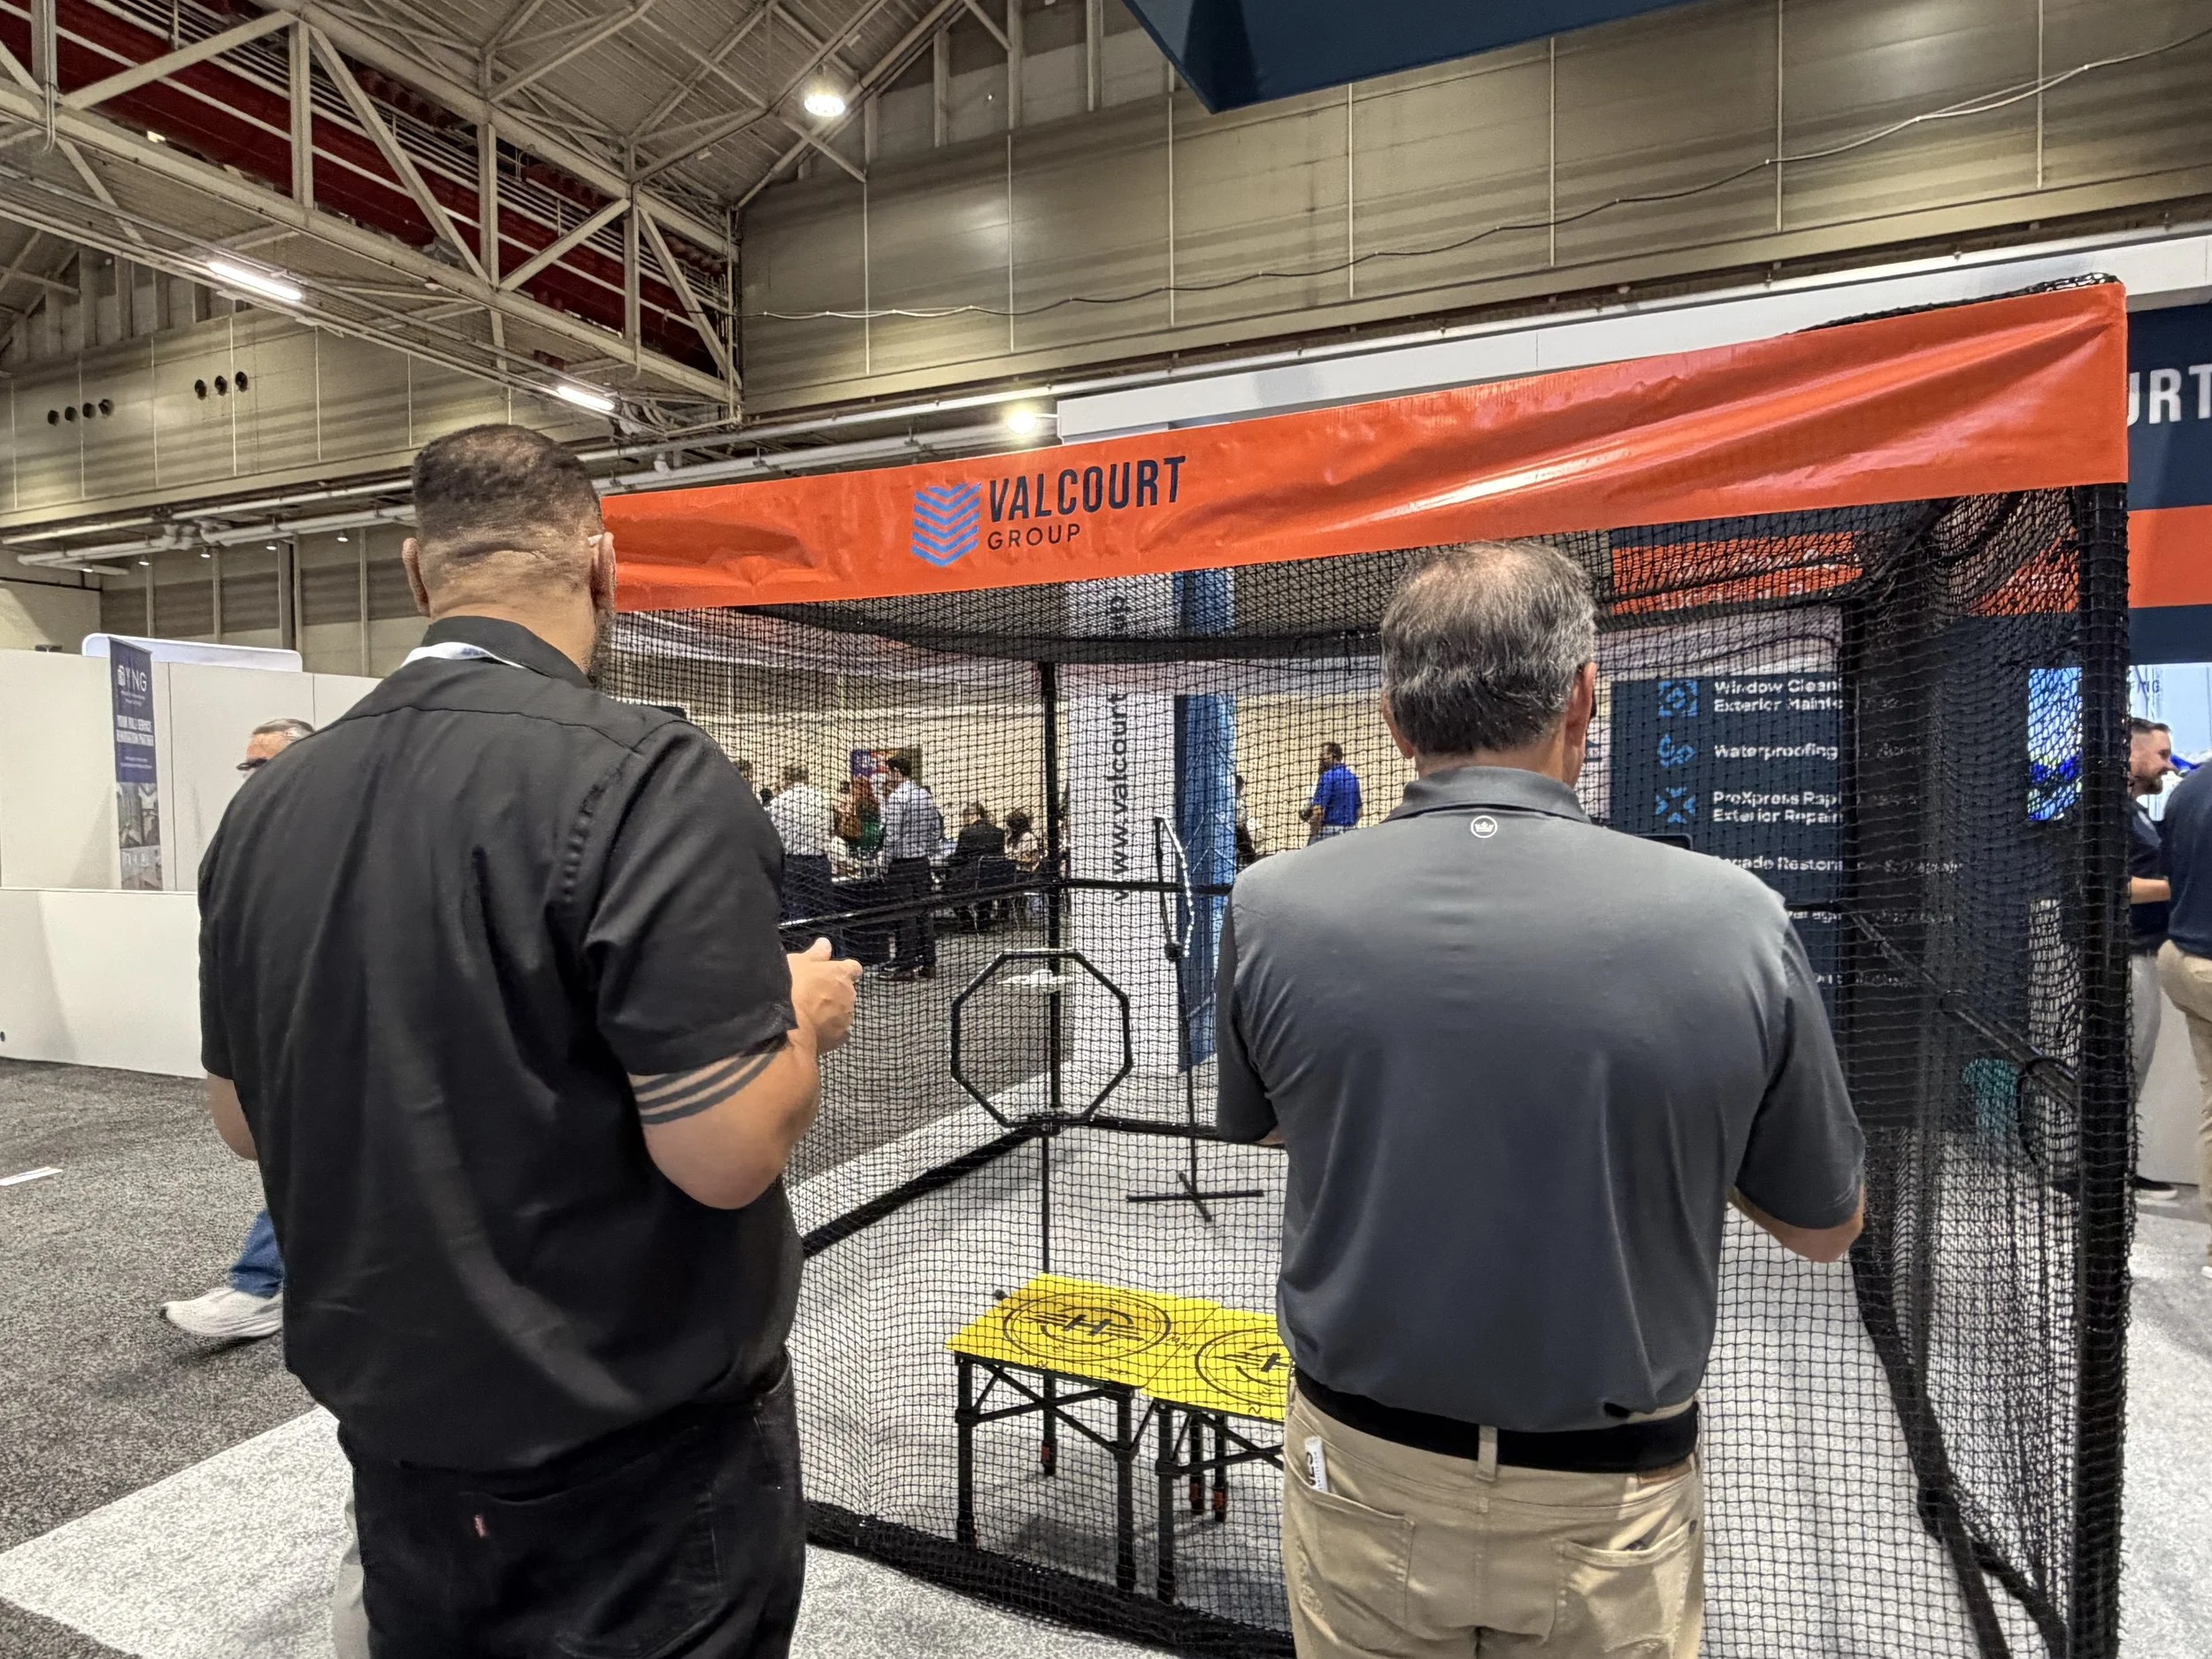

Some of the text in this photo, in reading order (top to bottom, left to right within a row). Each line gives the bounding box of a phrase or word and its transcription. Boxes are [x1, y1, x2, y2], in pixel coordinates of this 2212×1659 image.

[989, 456, 1186, 523] VALCOURT
[987, 523, 1081, 550] GROUP
[1714, 680, 1783, 695] Window
[1714, 698, 1782, 712] Exterior
[1714, 743, 1839, 761] Waterproofing
[1712, 791, 1800, 808] ProXpress
[1712, 809, 1780, 824] Exterior
